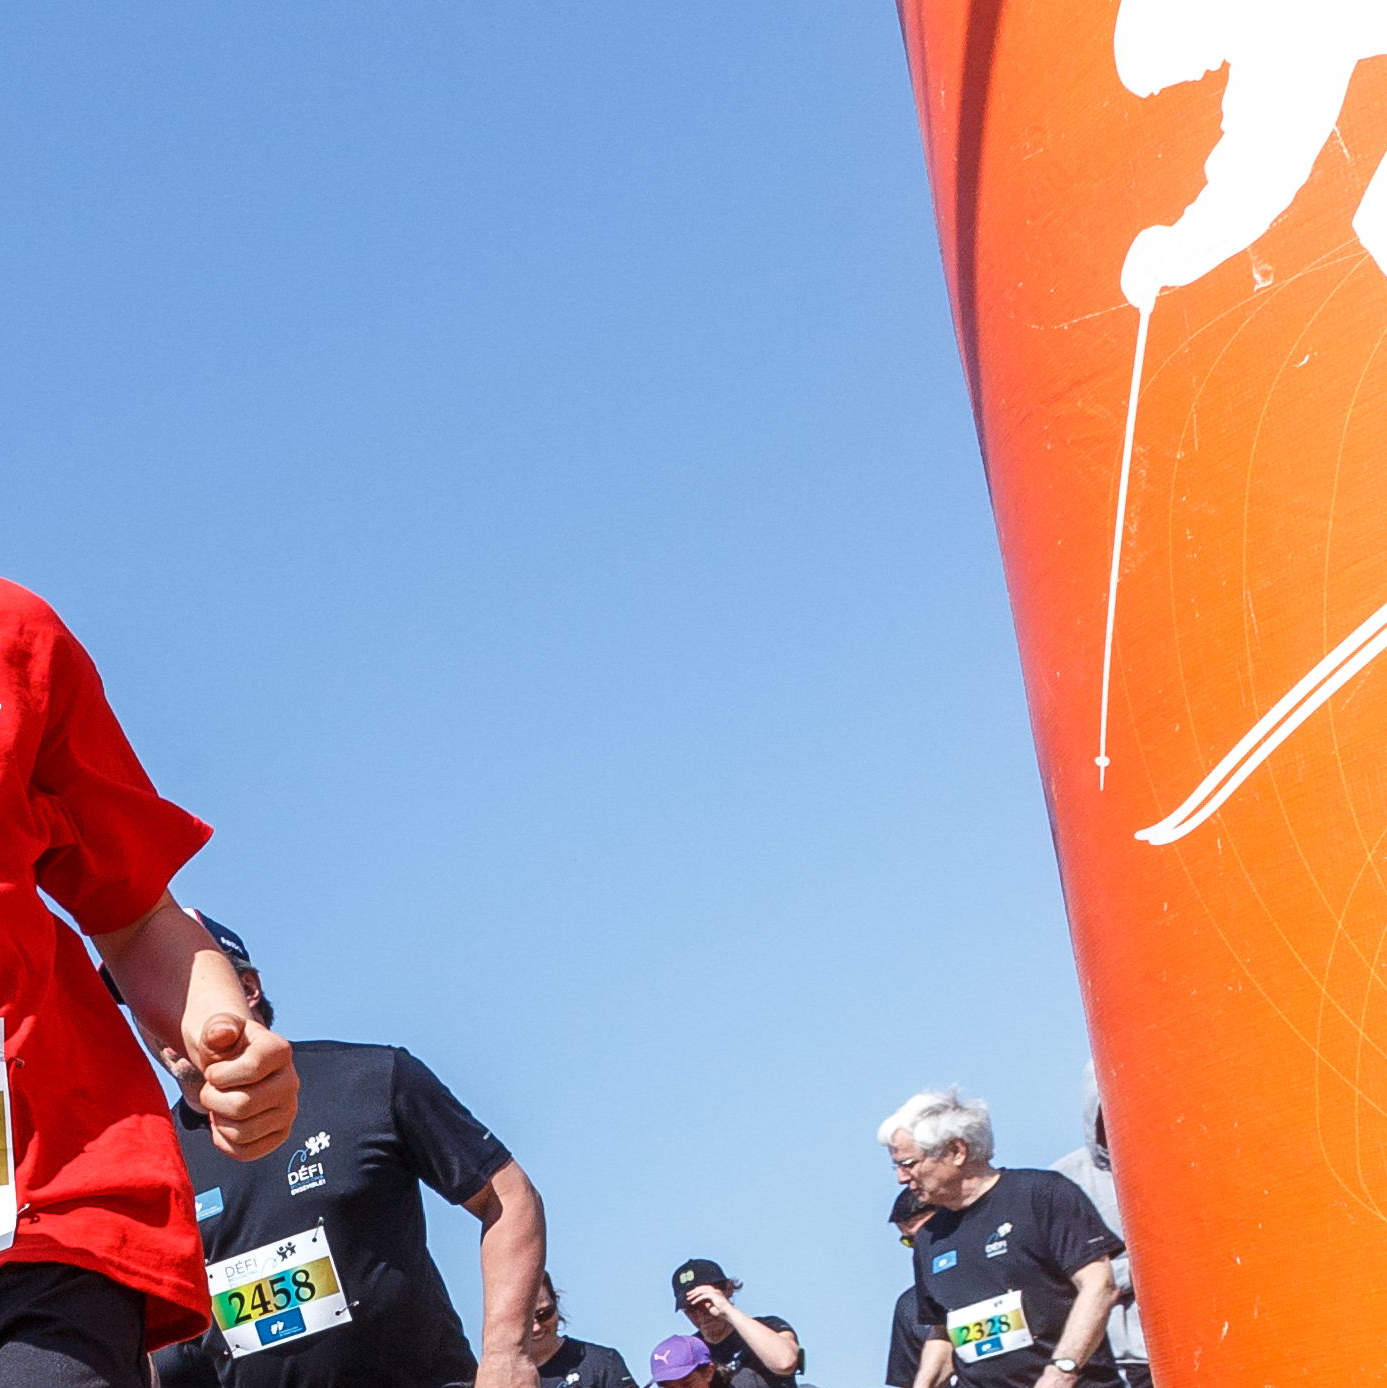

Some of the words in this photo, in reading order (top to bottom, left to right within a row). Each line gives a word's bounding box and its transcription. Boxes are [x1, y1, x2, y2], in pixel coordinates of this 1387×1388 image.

[288, 1163, 324, 1185] DÉFI
[225, 1258, 258, 1279] DÉFI
[228, 1269, 316, 1325] 2458
[960, 1315, 1011, 1345] 2328
